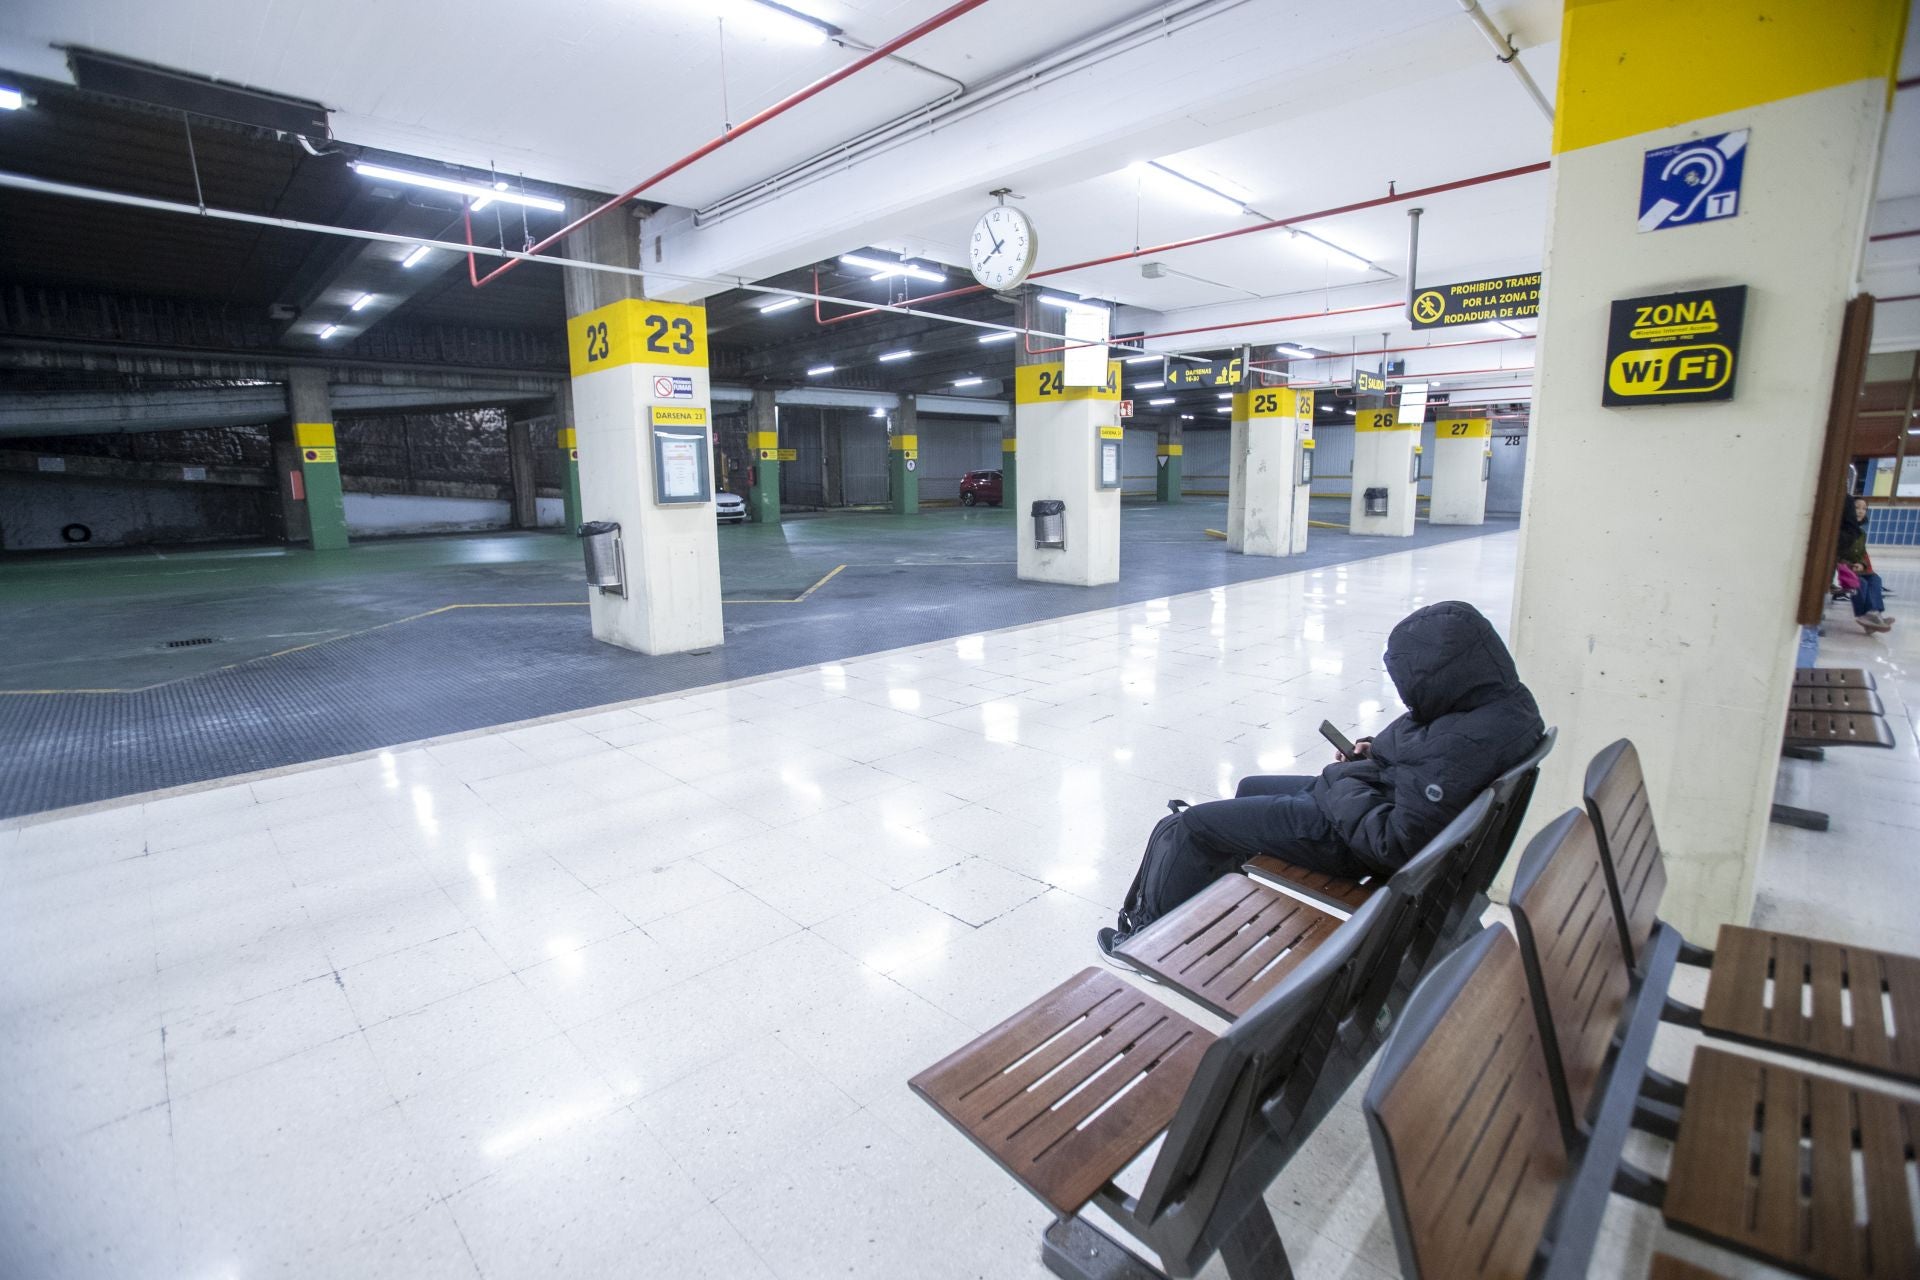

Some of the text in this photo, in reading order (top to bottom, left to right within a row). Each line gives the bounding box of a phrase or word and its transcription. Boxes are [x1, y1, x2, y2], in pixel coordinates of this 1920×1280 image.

[1712, 194, 1731, 214] T
[1450, 280, 1503, 296] PROHIBIDO
[1462, 297, 1482, 308] POR
[1484, 295, 1497, 306] LA
[1499, 292, 1527, 304] ZONA
[1444, 309, 1497, 324] RODADURA
[1500, 307, 1513, 317] DE
[1633, 299, 1717, 327] ZONA
[586, 321, 610, 363] 23
[645, 314, 695, 355] 23
[1039, 370, 1064, 396] 24
[1254, 394, 1278, 413] 25
[1299, 396, 1311, 414] 25
[656, 411, 692, 420] DARSENA
[1373, 413, 1393, 428] 26
[1451, 423, 1469, 435] 27
[1505, 435, 1520, 446] 28
